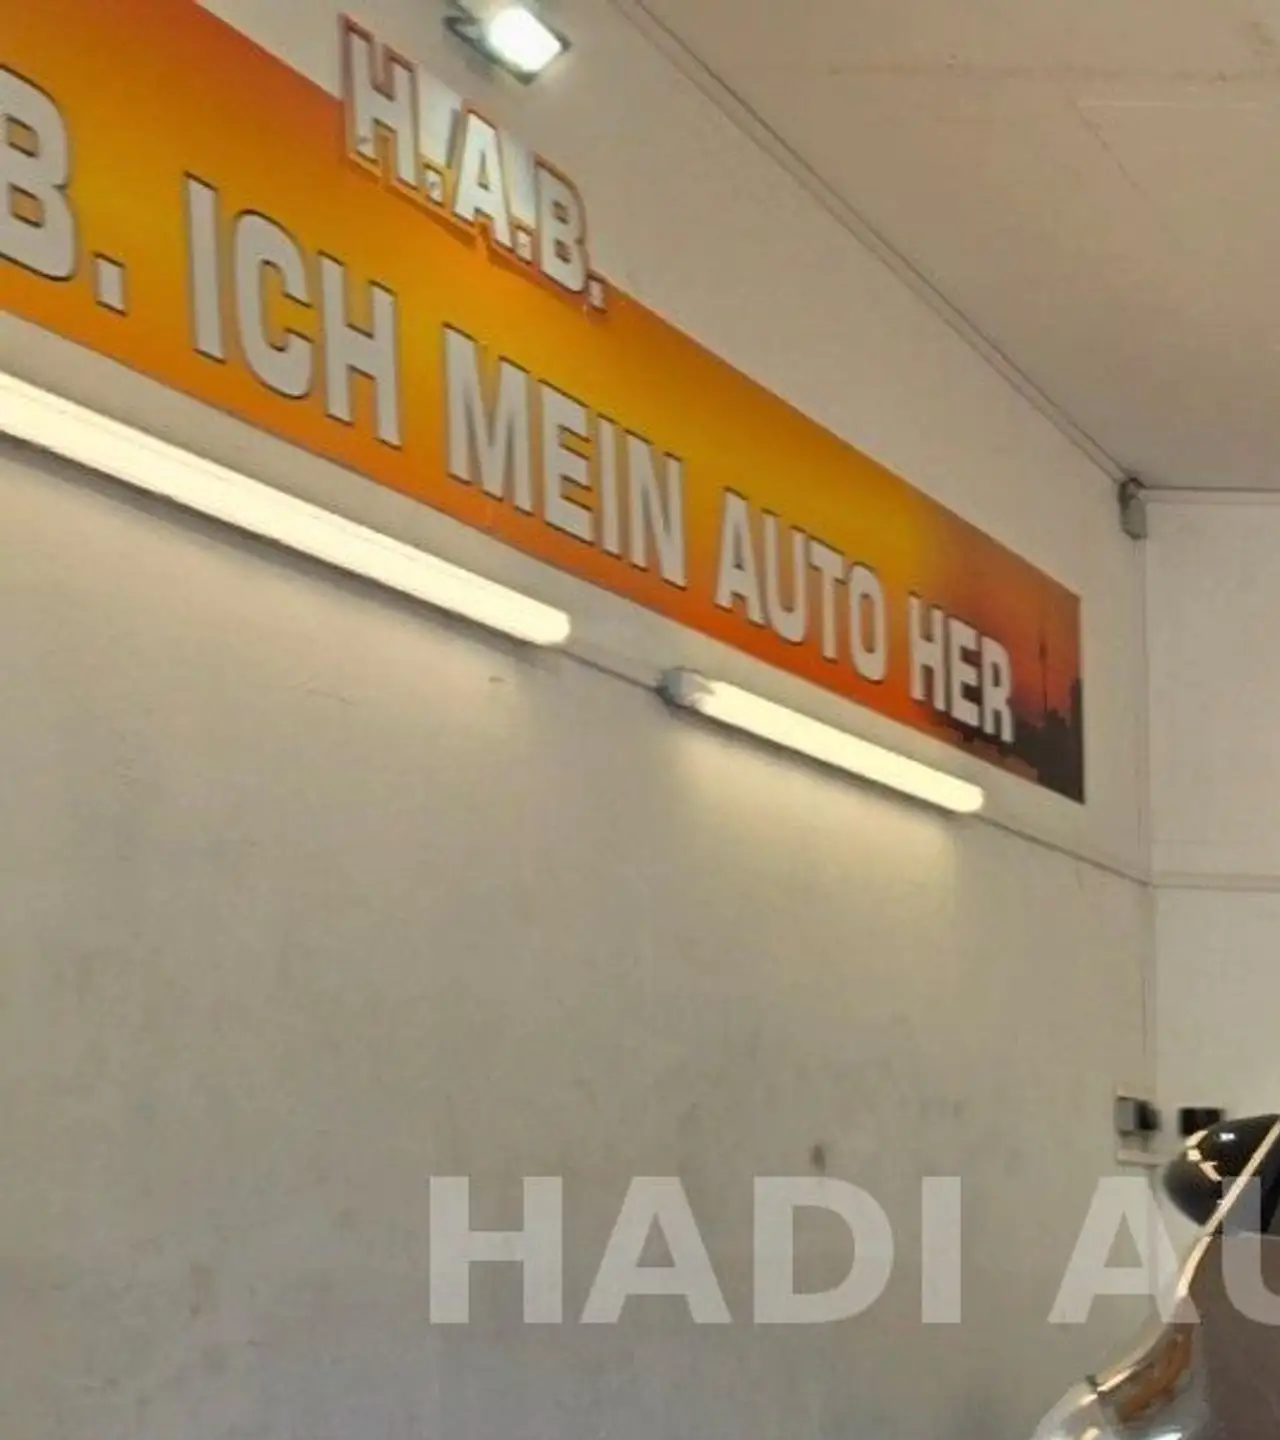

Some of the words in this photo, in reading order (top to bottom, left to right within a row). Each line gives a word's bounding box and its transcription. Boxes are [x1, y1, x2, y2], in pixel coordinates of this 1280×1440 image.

[341, 13, 606, 311] H.A.B.
[183, 171, 403, 448] ICH
[443, 322, 687, 588] MEIN
[714, 487, 889, 686] AUTO
[907, 590, 1016, 745] HER
